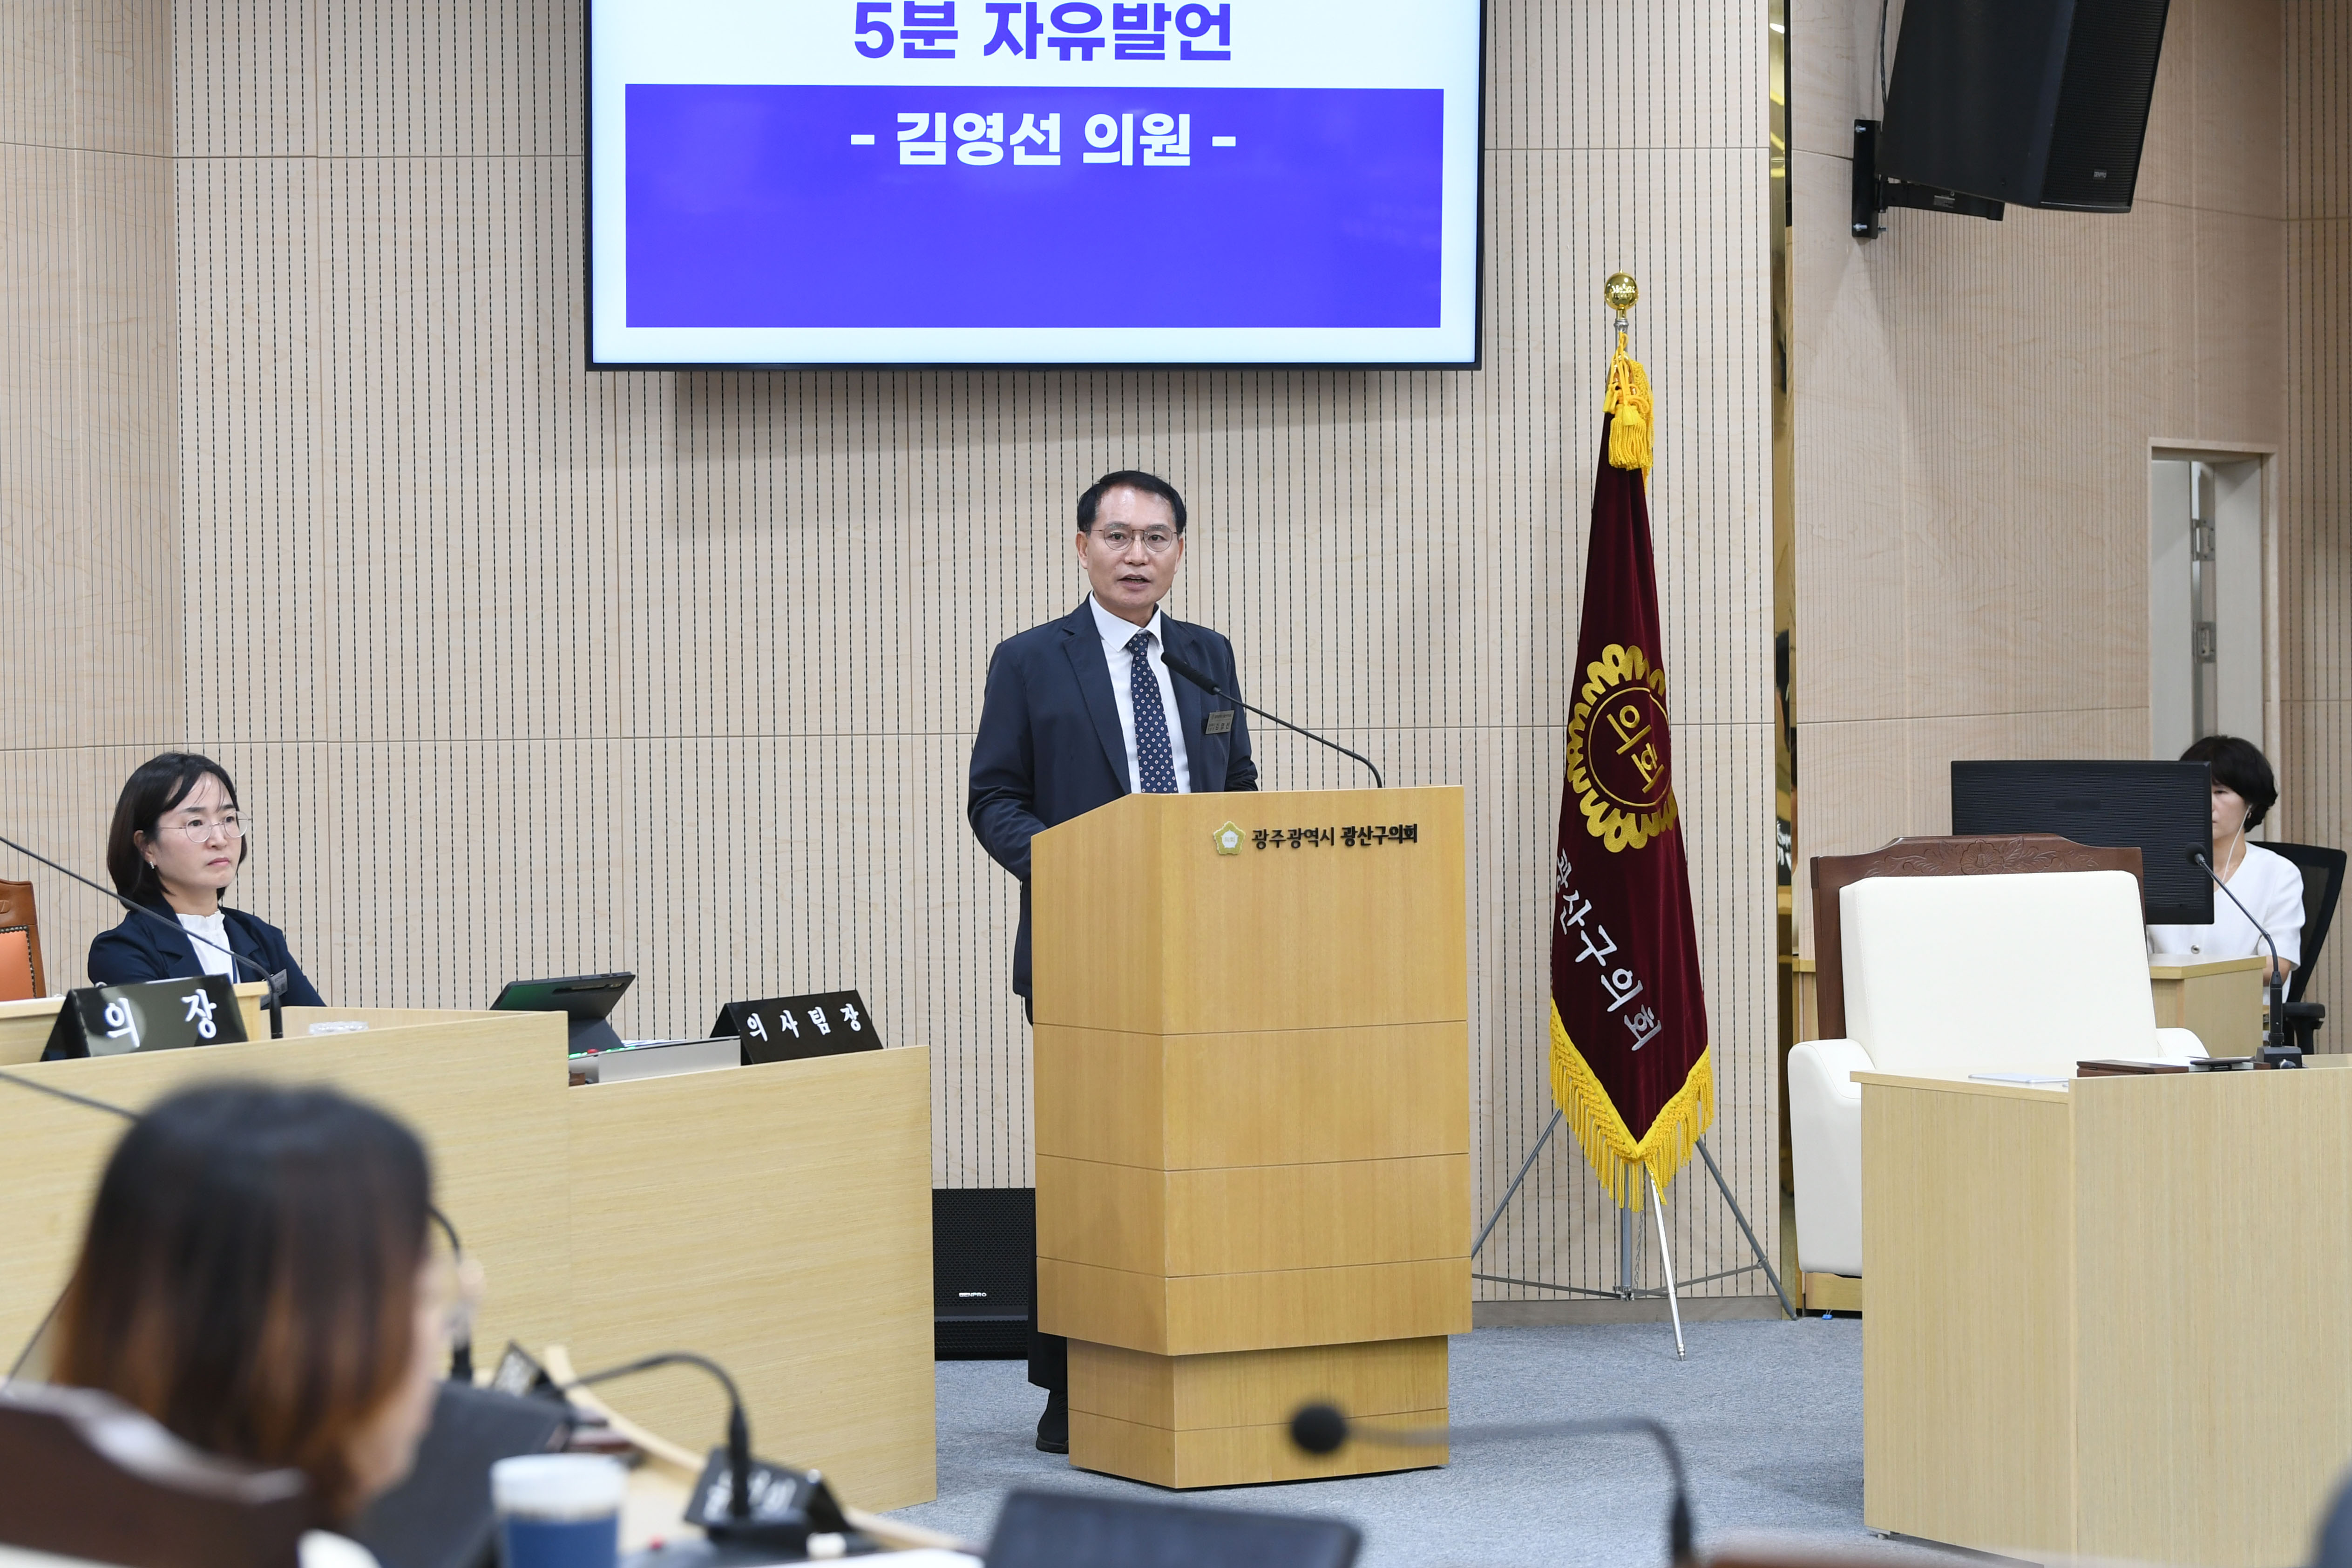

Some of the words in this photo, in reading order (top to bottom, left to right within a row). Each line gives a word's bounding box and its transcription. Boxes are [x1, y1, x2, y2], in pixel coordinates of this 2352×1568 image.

[854, 1, 958, 59] 5분
[983, 1, 1232, 61] 자유발언
[851, 135, 875, 145] -
[896, 113, 1061, 166] 김영선
[1083, 114, 1191, 166] 의원
[1213, 136, 1236, 147] -
[1606, 705, 1665, 793] 의회
[1252, 827, 1335, 850] 광주광역시
[1341, 823, 1418, 847] 광산구의회
[1556, 848, 1661, 1051] 광산구의회
[746, 1003, 862, 1042] 의사팀장
